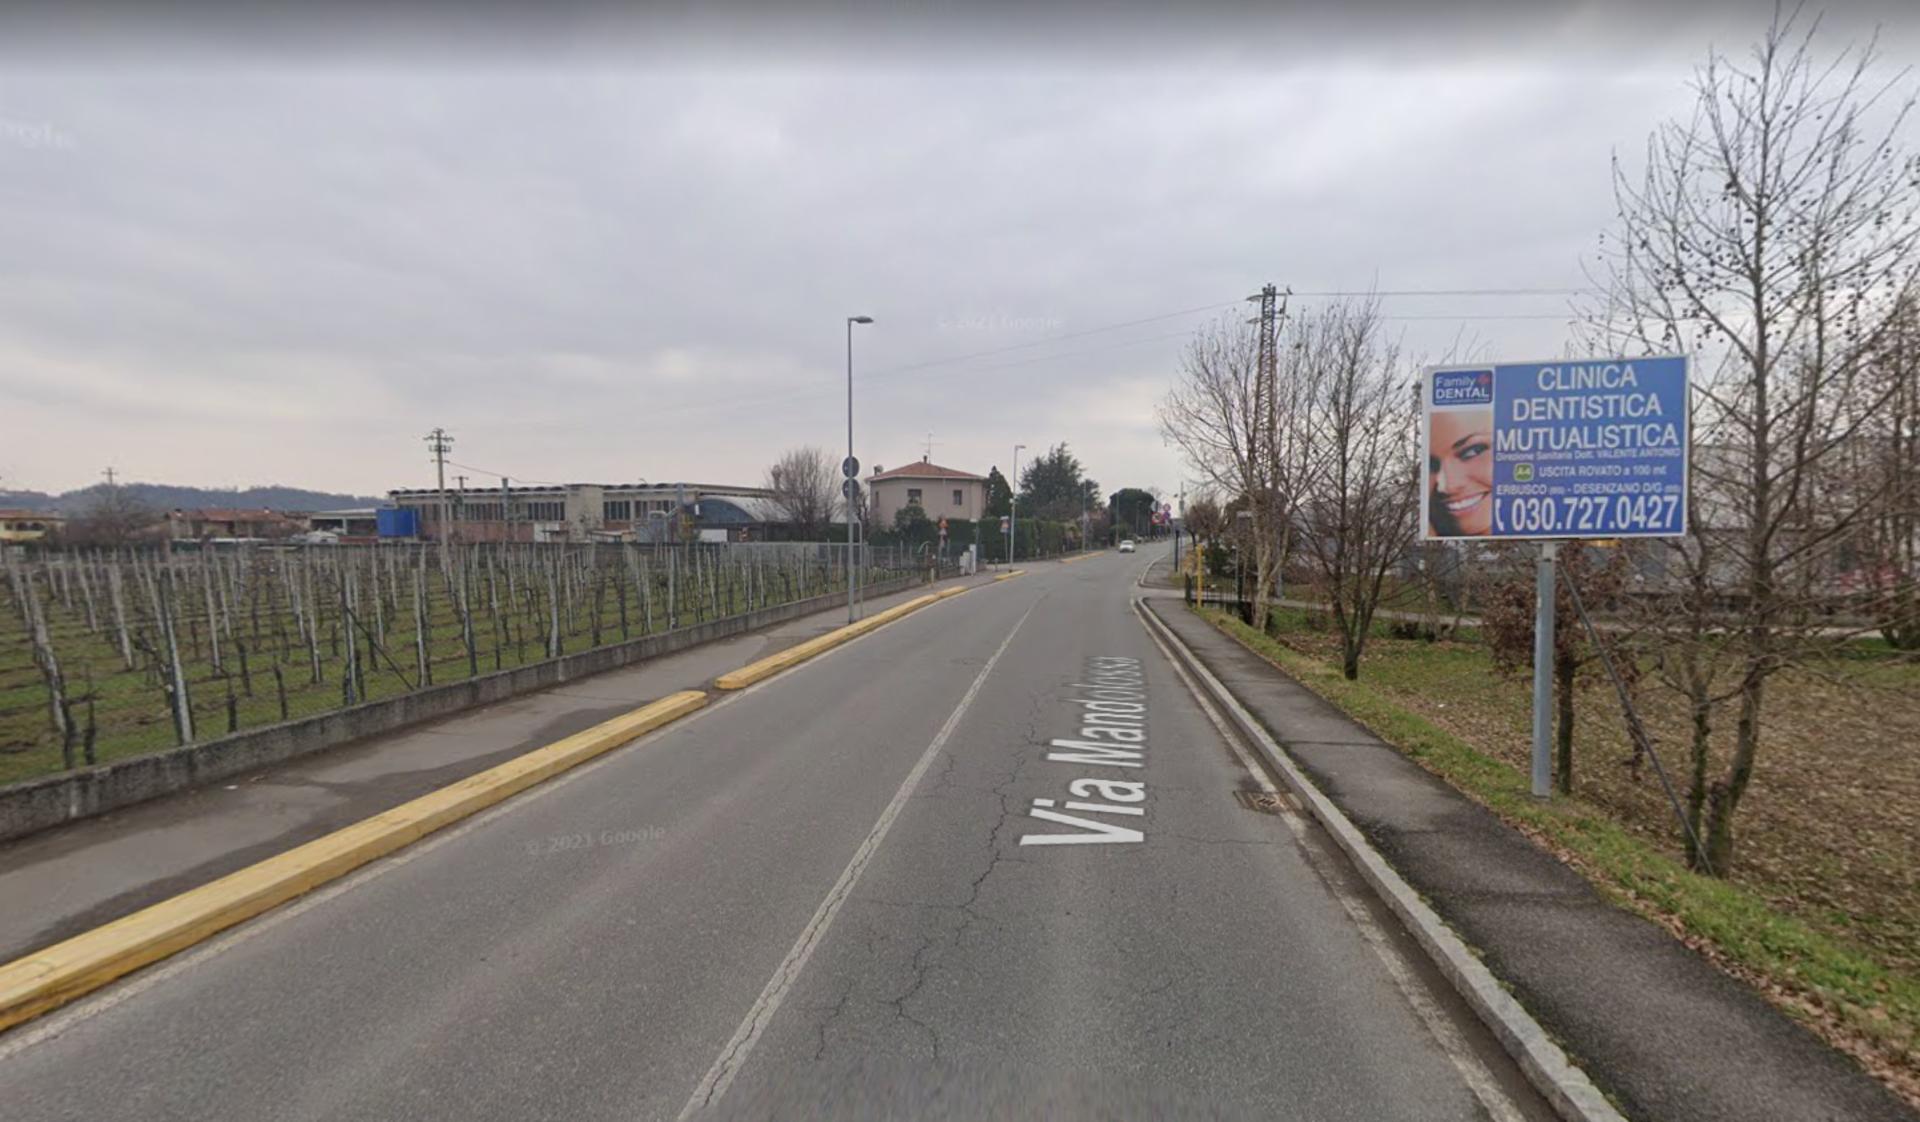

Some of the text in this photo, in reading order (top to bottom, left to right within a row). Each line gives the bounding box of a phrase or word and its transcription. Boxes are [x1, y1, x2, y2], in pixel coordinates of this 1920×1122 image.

[1436, 376, 1476, 389] Family
[1537, 364, 1638, 391] CLINICA
[1436, 387, 1489, 399] DENTAL
[1513, 393, 1662, 422] DENTISTICA
[1496, 423, 1679, 452] MUTUALISTICA
[1539, 466, 1576, 477] USCITA
[1578, 465, 1622, 476] ROVATO
[1623, 467, 1631, 476] a
[1632, 464, 1651, 476] 100
[1496, 484, 1547, 495] ERBUSCO
[1573, 483, 1640, 495] DESENZANO
[1511, 495, 1679, 531] 030.727.0427
